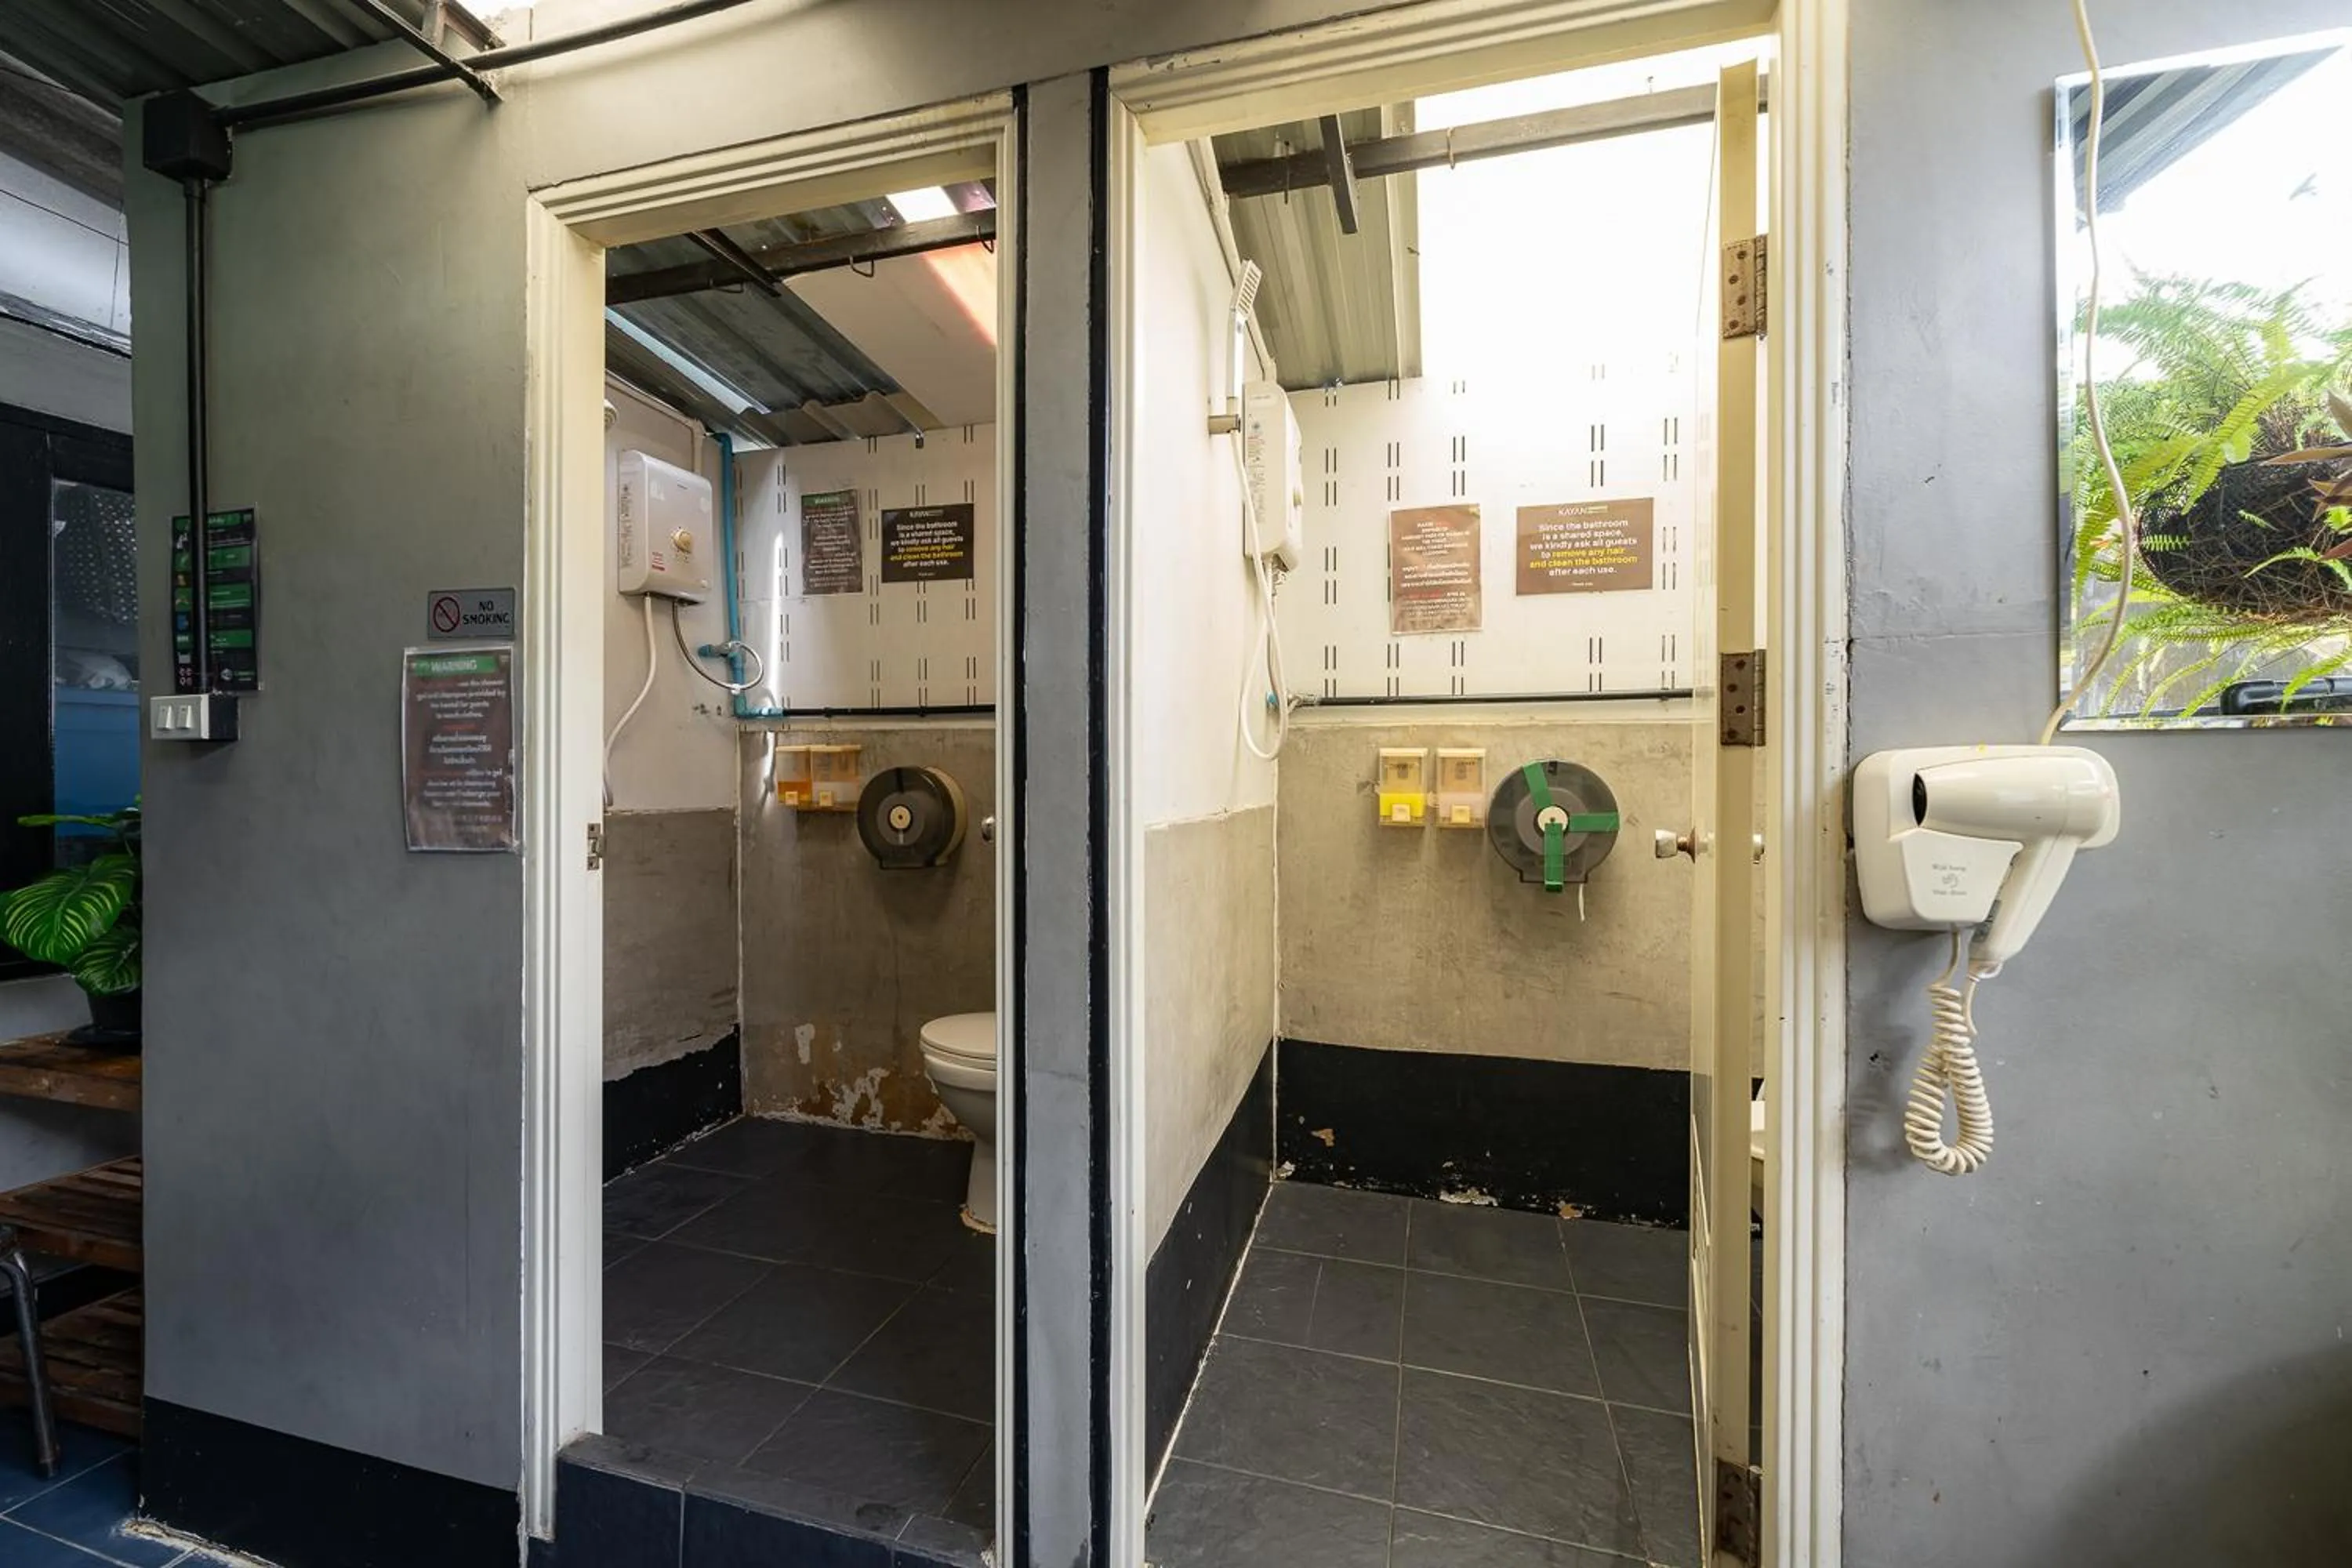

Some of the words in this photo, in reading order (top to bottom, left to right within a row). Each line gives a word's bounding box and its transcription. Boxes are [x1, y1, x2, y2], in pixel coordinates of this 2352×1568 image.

[1558, 507, 1587, 517] KAYAN
[1583, 519, 1628, 529] bathroom
[1560, 530, 1592, 539] shared
[1545, 539, 1572, 550] kindly
[1574, 539, 1590, 548] ask
[1605, 537, 1637, 548] guests
[1588, 549, 1604, 557] any
[1530, 560, 1547, 568] and
[1548, 559, 1573, 568] clean
[1592, 555, 1638, 565] bathroom
[1548, 568, 1571, 576] after
[1573, 567, 1595, 575] each
[478, 601, 494, 612] NO
[463, 612, 510, 626] SMOKING
